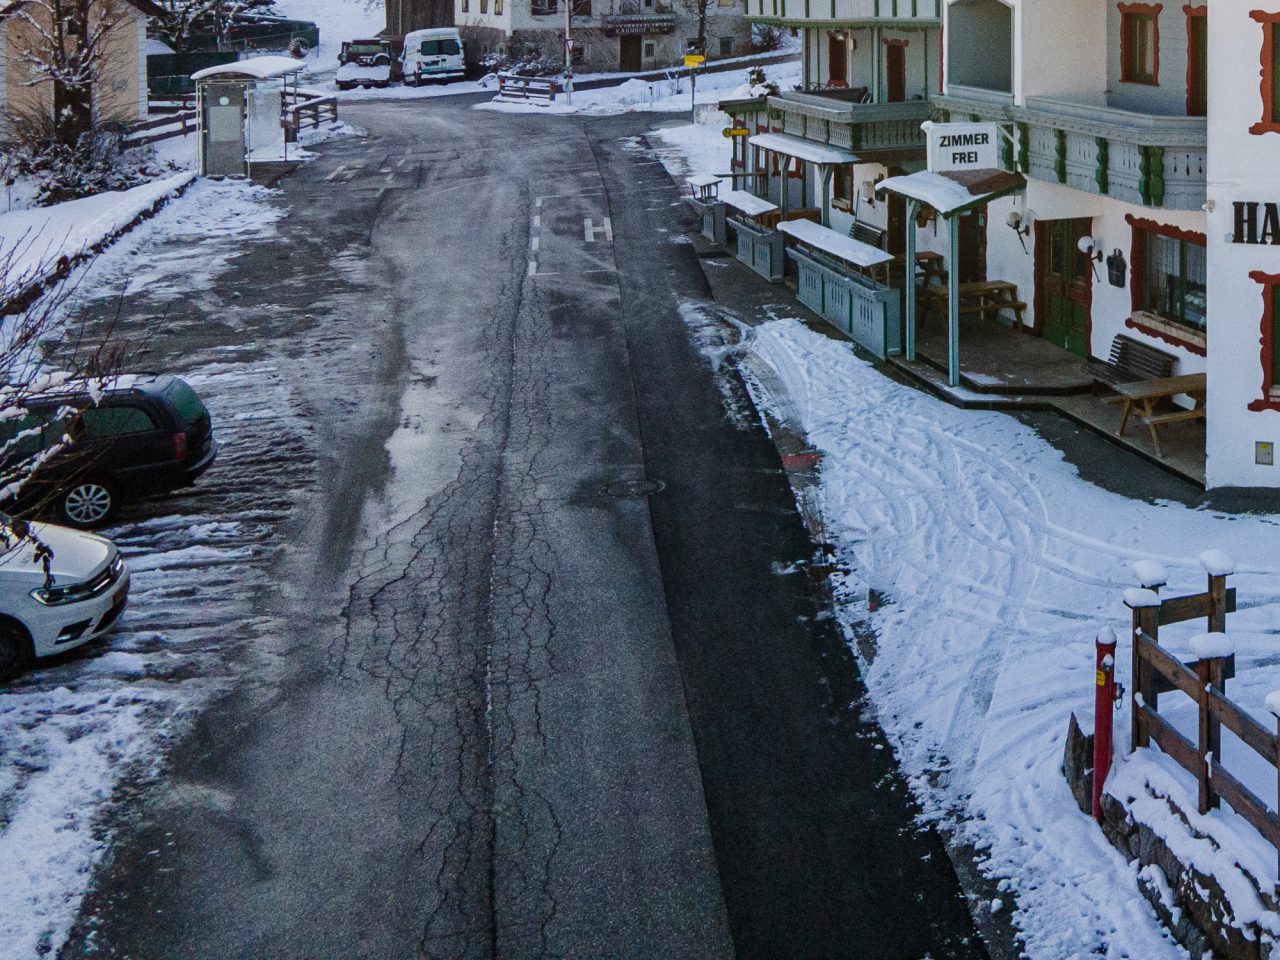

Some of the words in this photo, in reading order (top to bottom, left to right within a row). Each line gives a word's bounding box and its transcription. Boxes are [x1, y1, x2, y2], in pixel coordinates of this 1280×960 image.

[939, 133, 989, 147] ZIMMER
[952, 151, 978, 164] FREI
[584, 216, 613, 242] H
